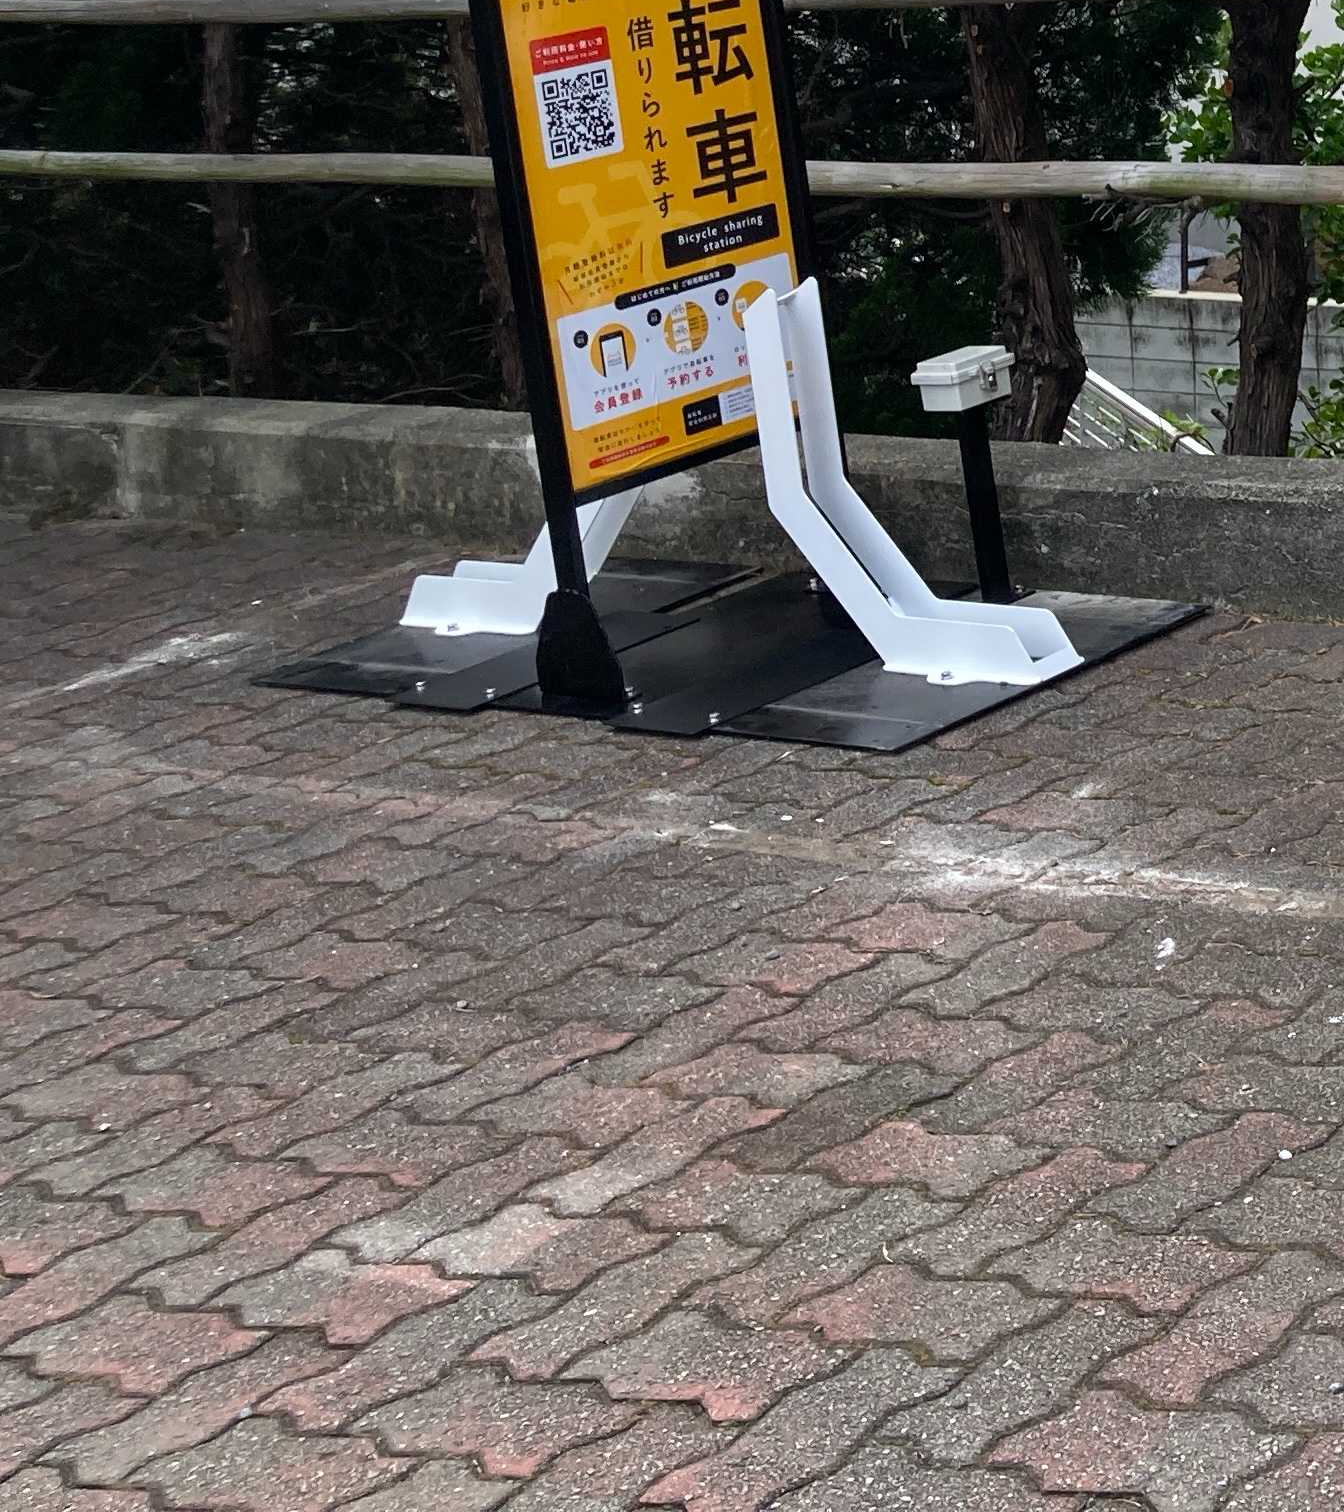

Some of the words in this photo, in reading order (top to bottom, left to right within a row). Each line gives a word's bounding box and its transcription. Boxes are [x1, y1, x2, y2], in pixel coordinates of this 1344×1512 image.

[626, 15, 675, 218] 借りられます
[677, 224, 718, 246] Bicycle
[724, 214, 764, 234] sharing
[703, 234, 743, 253] station
[667, 366, 715, 389] 予約する
[594, 388, 643, 414] 会員登録
